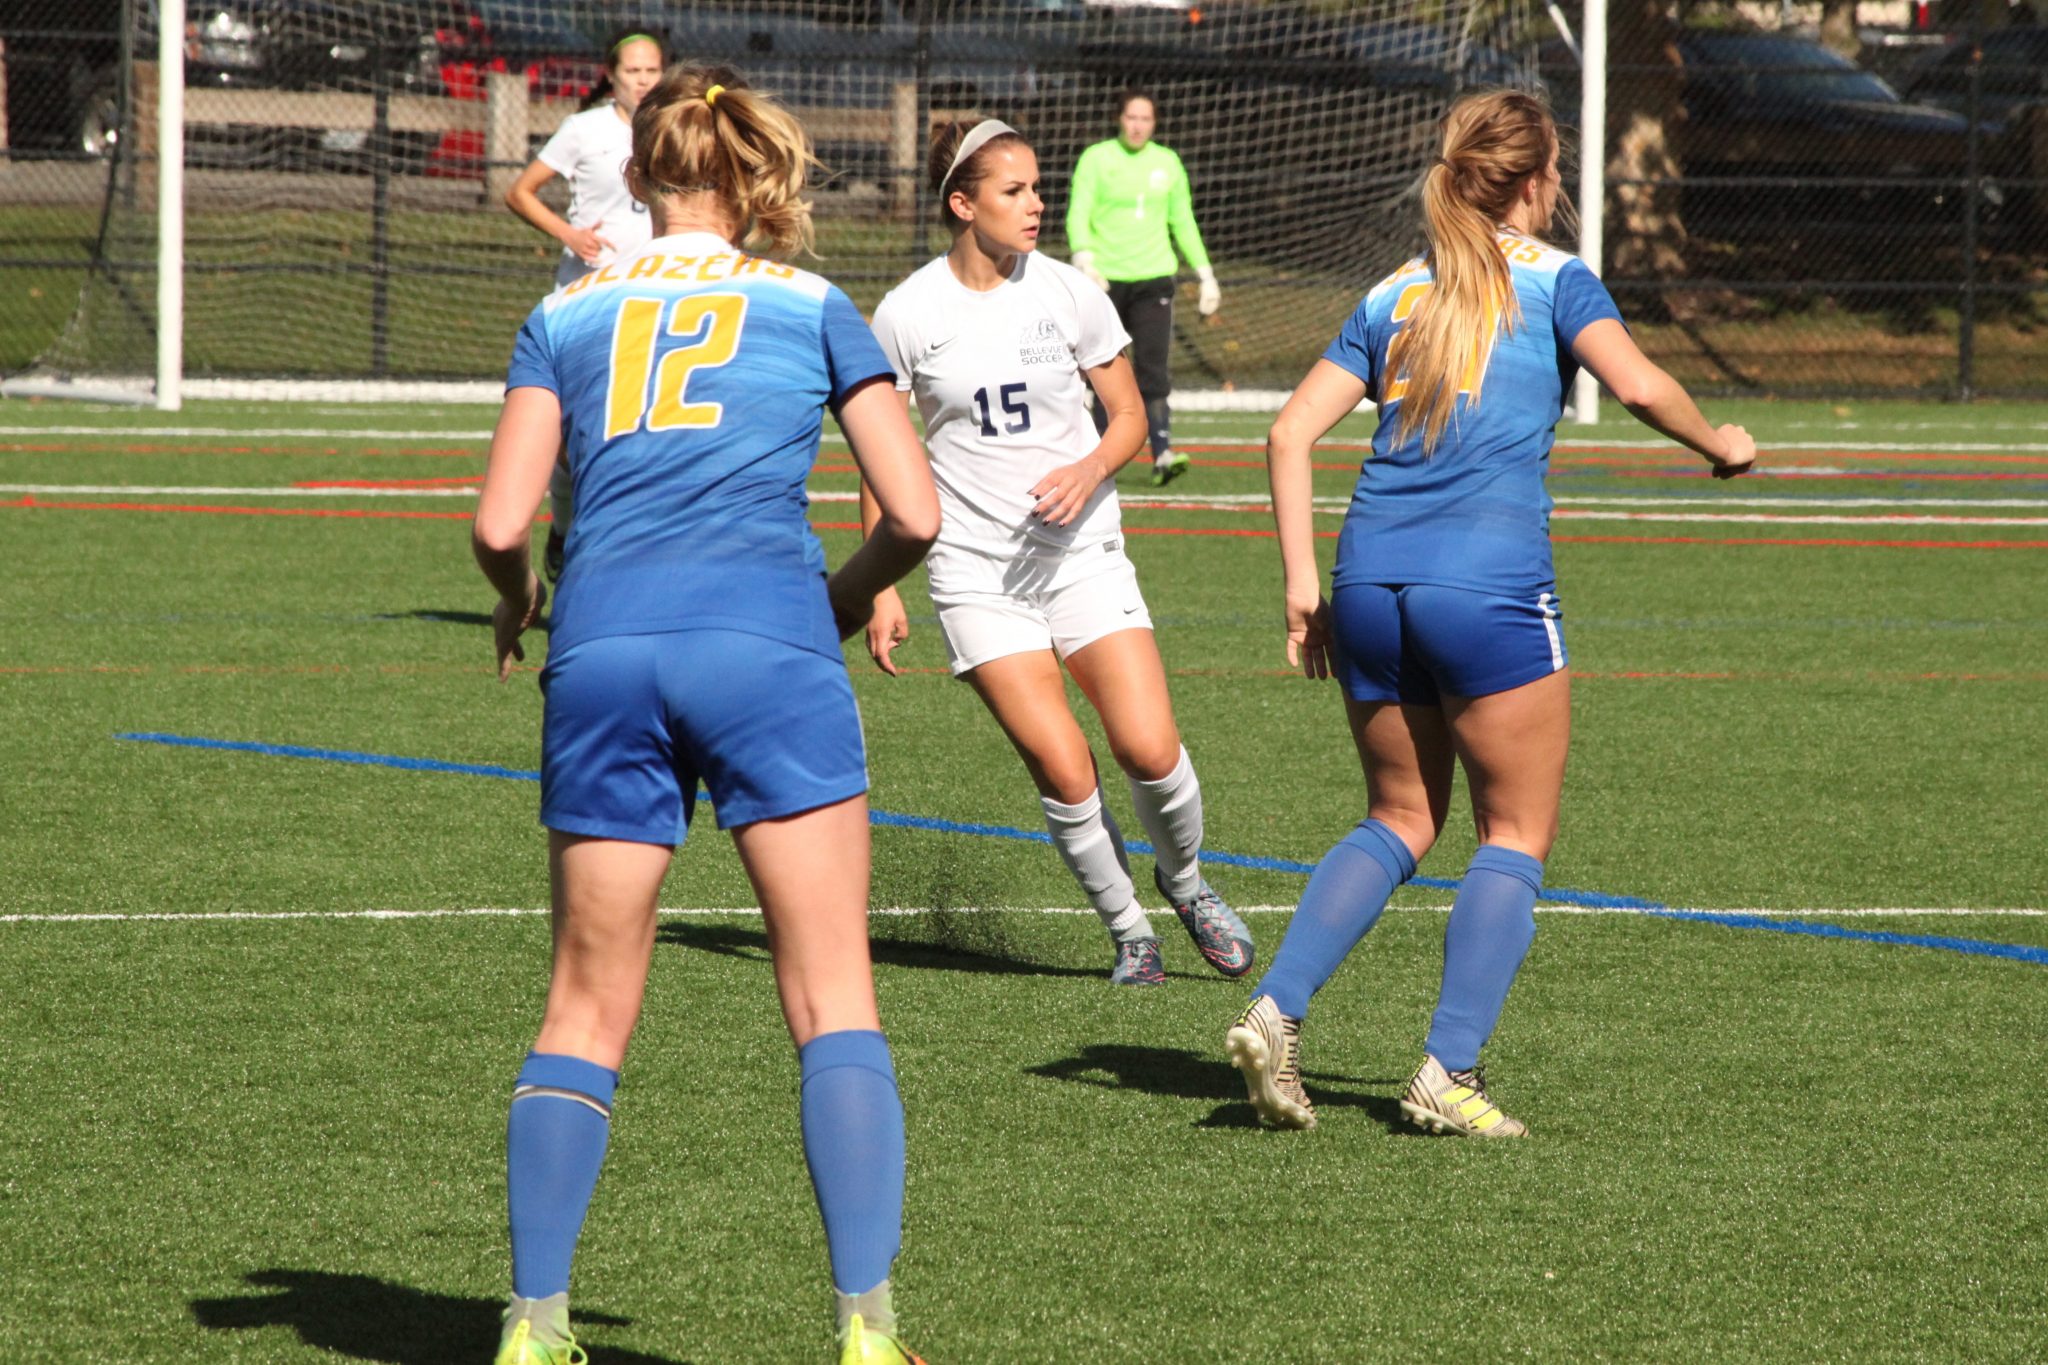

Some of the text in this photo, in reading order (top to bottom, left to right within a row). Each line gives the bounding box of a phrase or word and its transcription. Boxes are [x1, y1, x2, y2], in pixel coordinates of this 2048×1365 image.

[604, 291, 748, 441] 12
[1019, 345, 1062, 357] BELLEVUE
[1021, 354, 1063, 366] SOCCER
[973, 381, 1032, 437] 15
